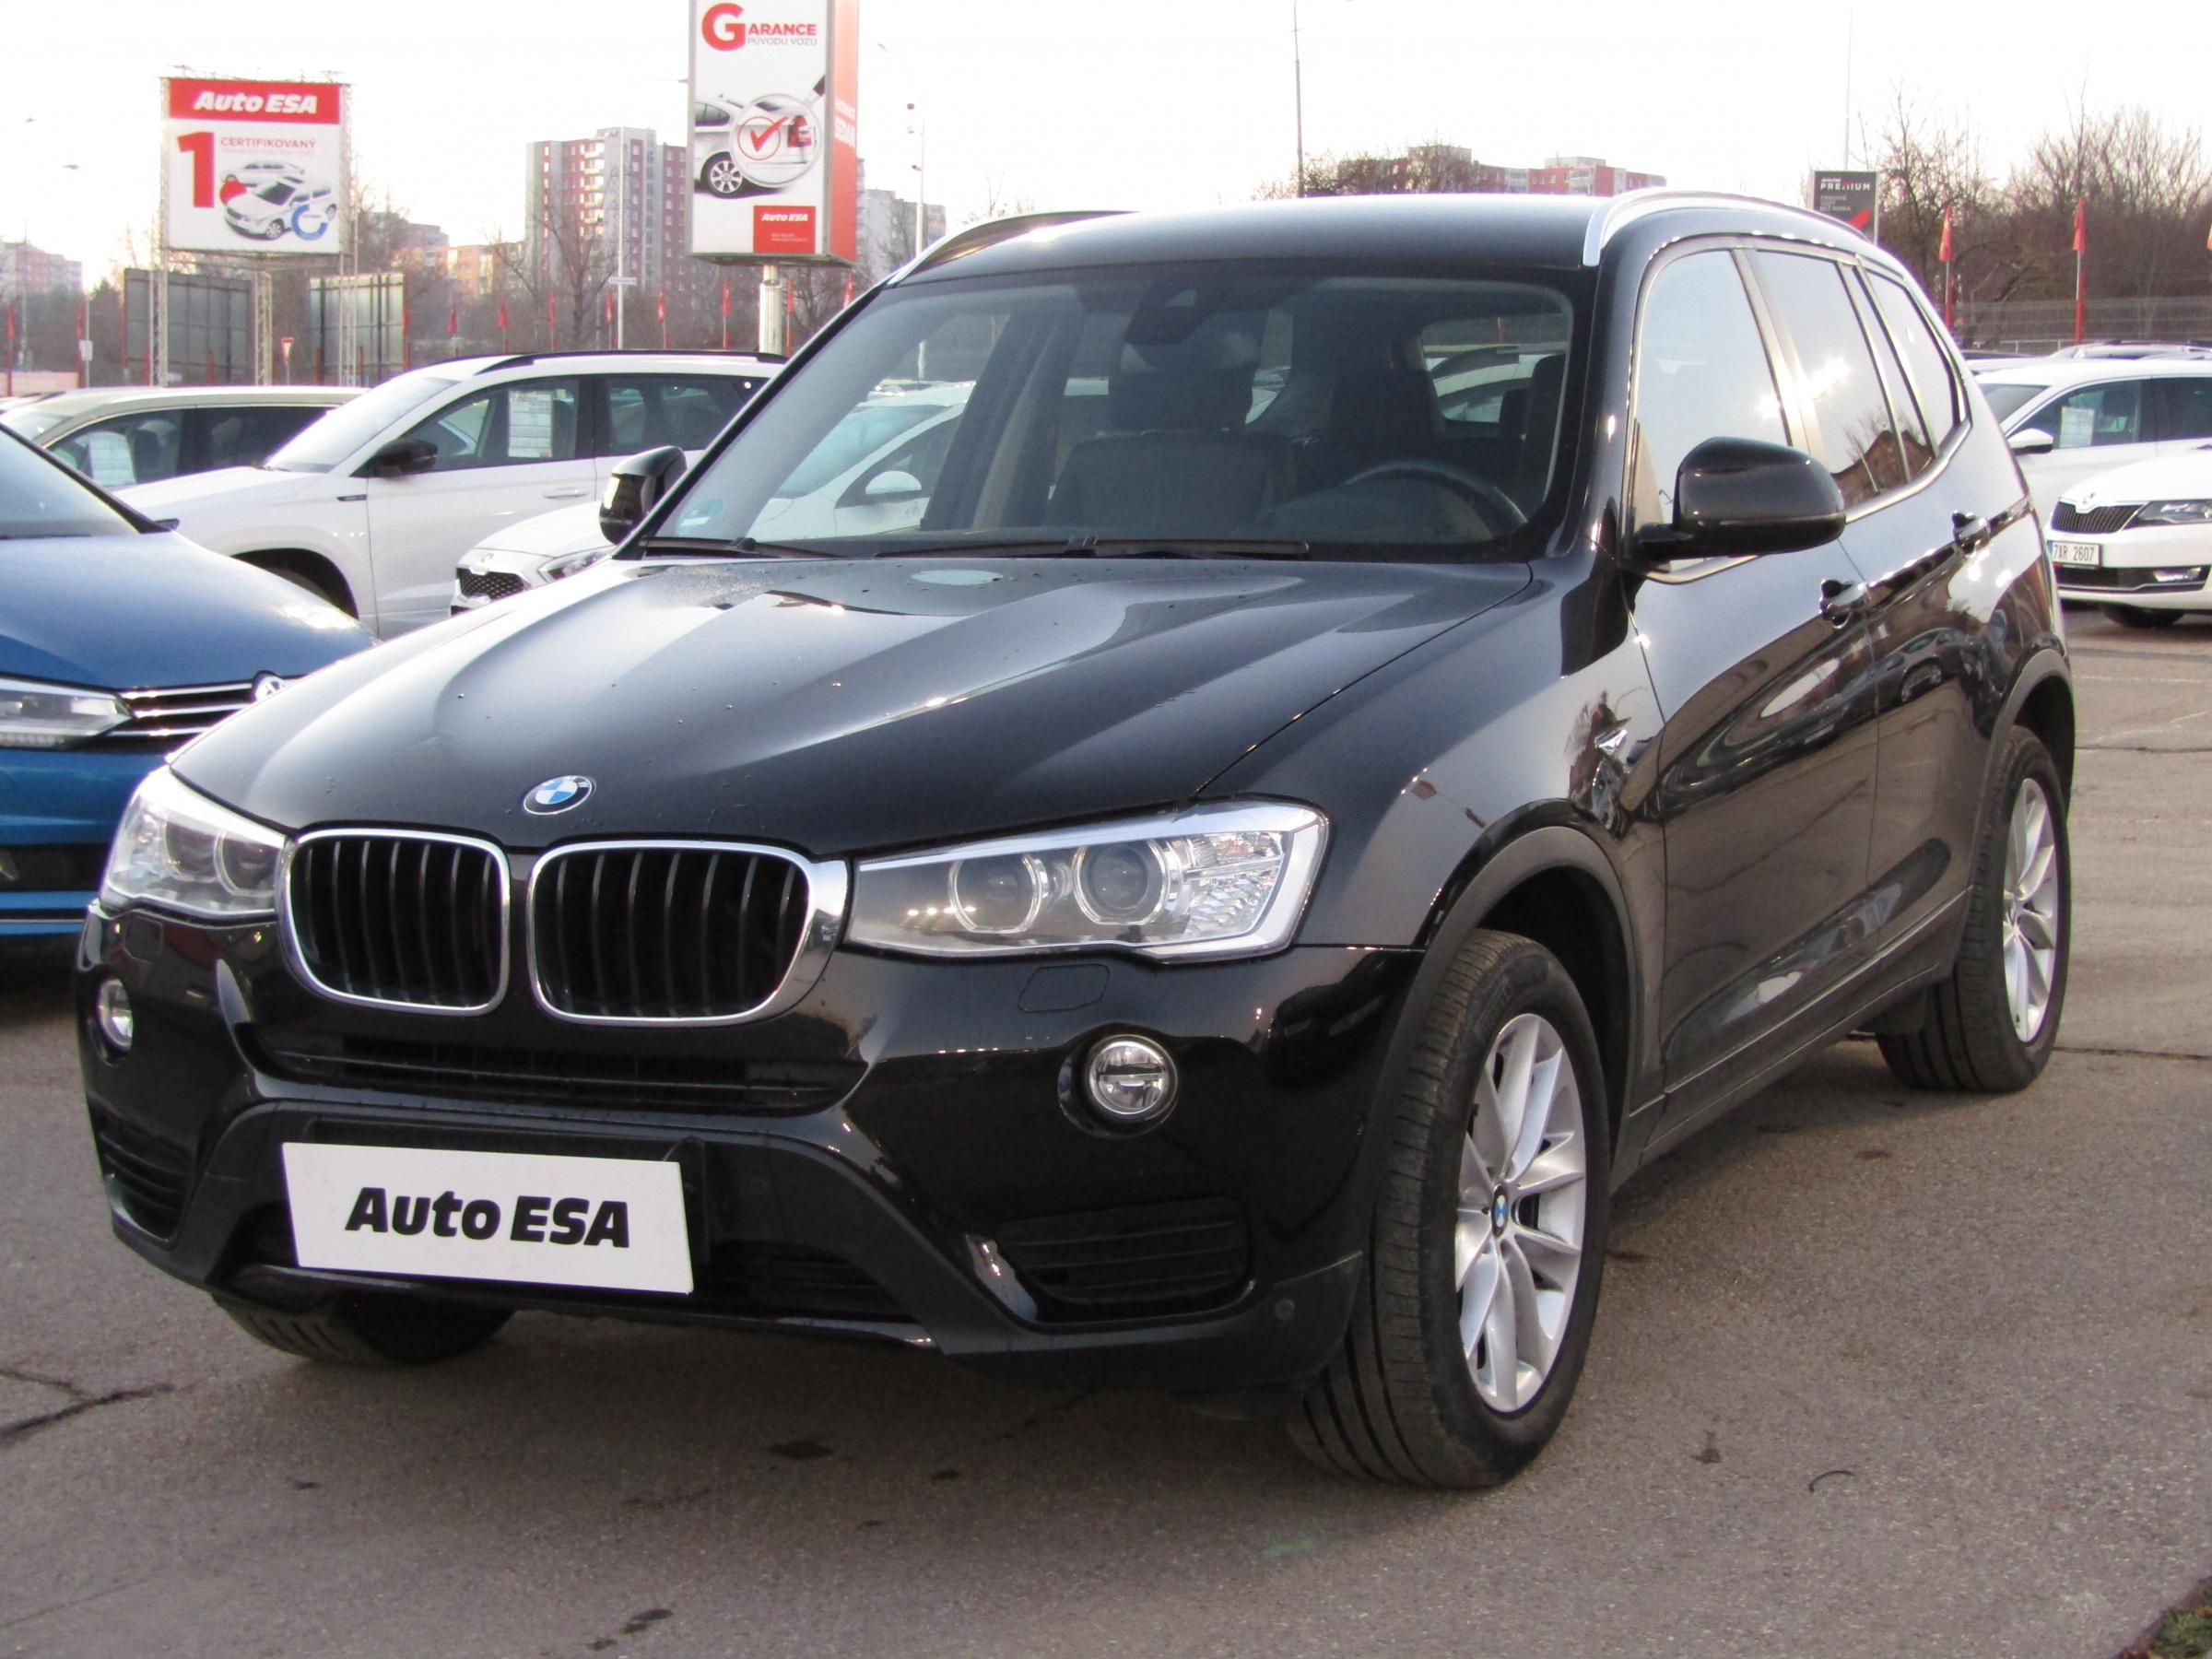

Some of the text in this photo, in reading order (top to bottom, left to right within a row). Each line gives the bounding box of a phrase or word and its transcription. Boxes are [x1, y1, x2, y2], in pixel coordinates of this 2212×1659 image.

[701, 3, 817, 52] GARANCE
[790, 38, 818, 46] VOZU
[193, 91, 318, 114] Auto ESA
[761, 213, 808, 221] Auto ESA
[2053, 544, 2095, 562] 7AR 2607
[345, 1186, 630, 1249] Auto ESA
